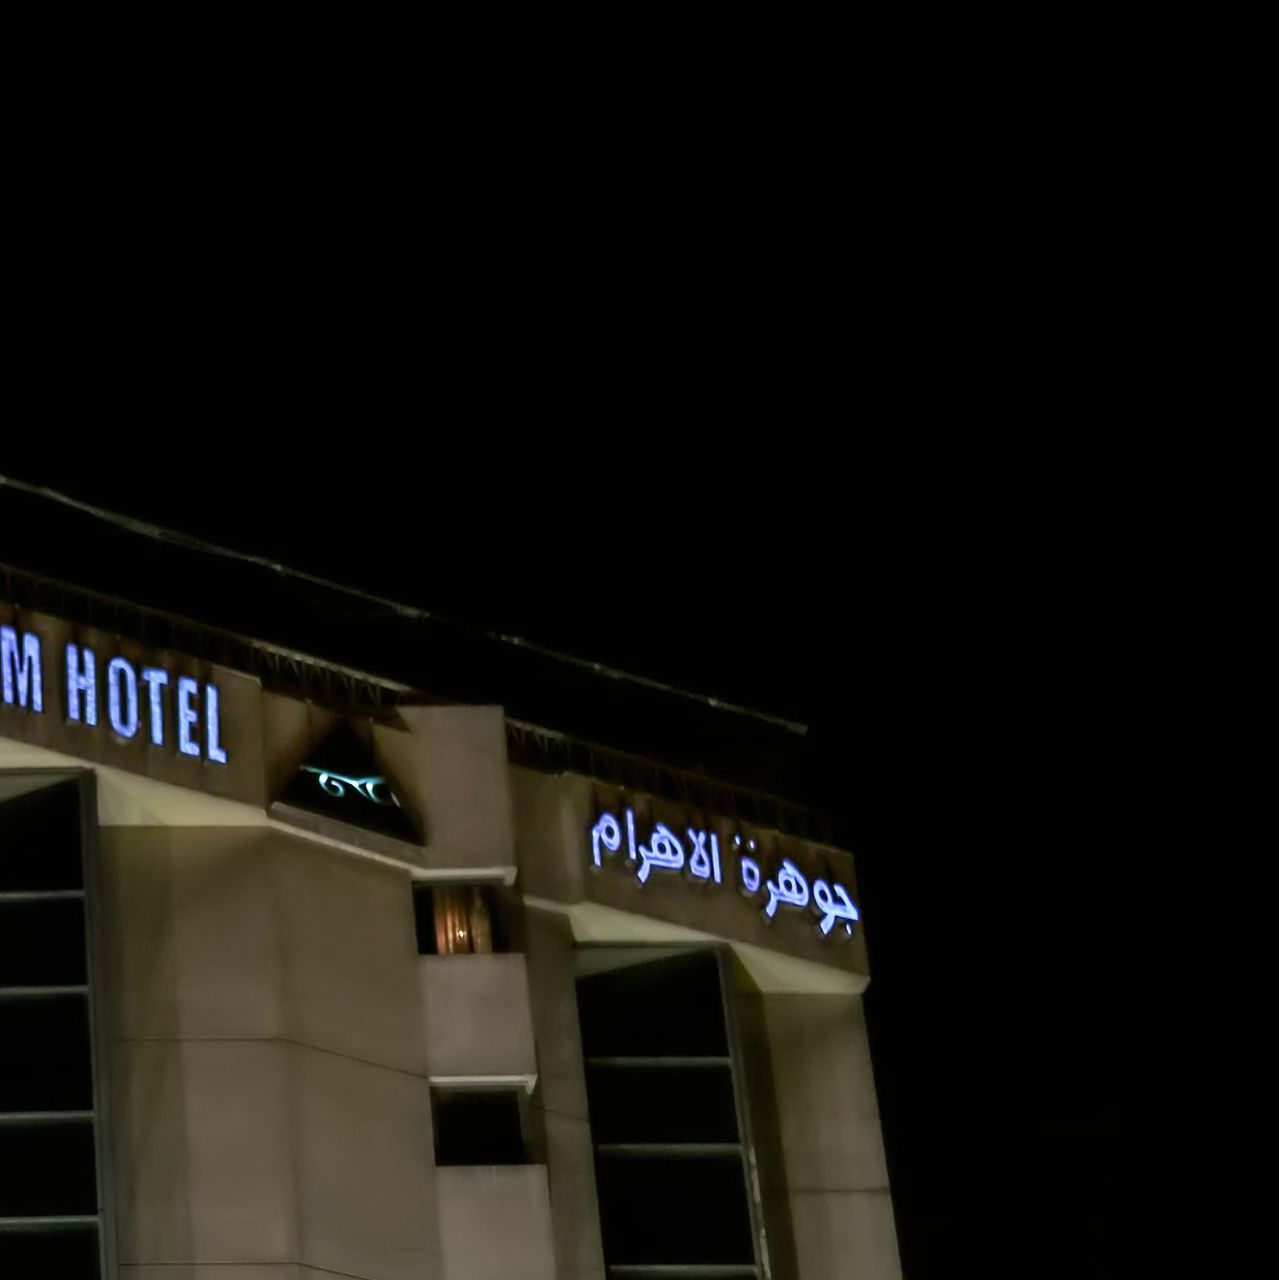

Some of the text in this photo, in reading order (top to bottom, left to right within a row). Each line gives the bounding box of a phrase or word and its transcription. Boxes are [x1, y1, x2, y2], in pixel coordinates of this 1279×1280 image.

[66, 643, 229, 767] HOTEL
[591, 808, 860, 936] جوهرة الاهرام
